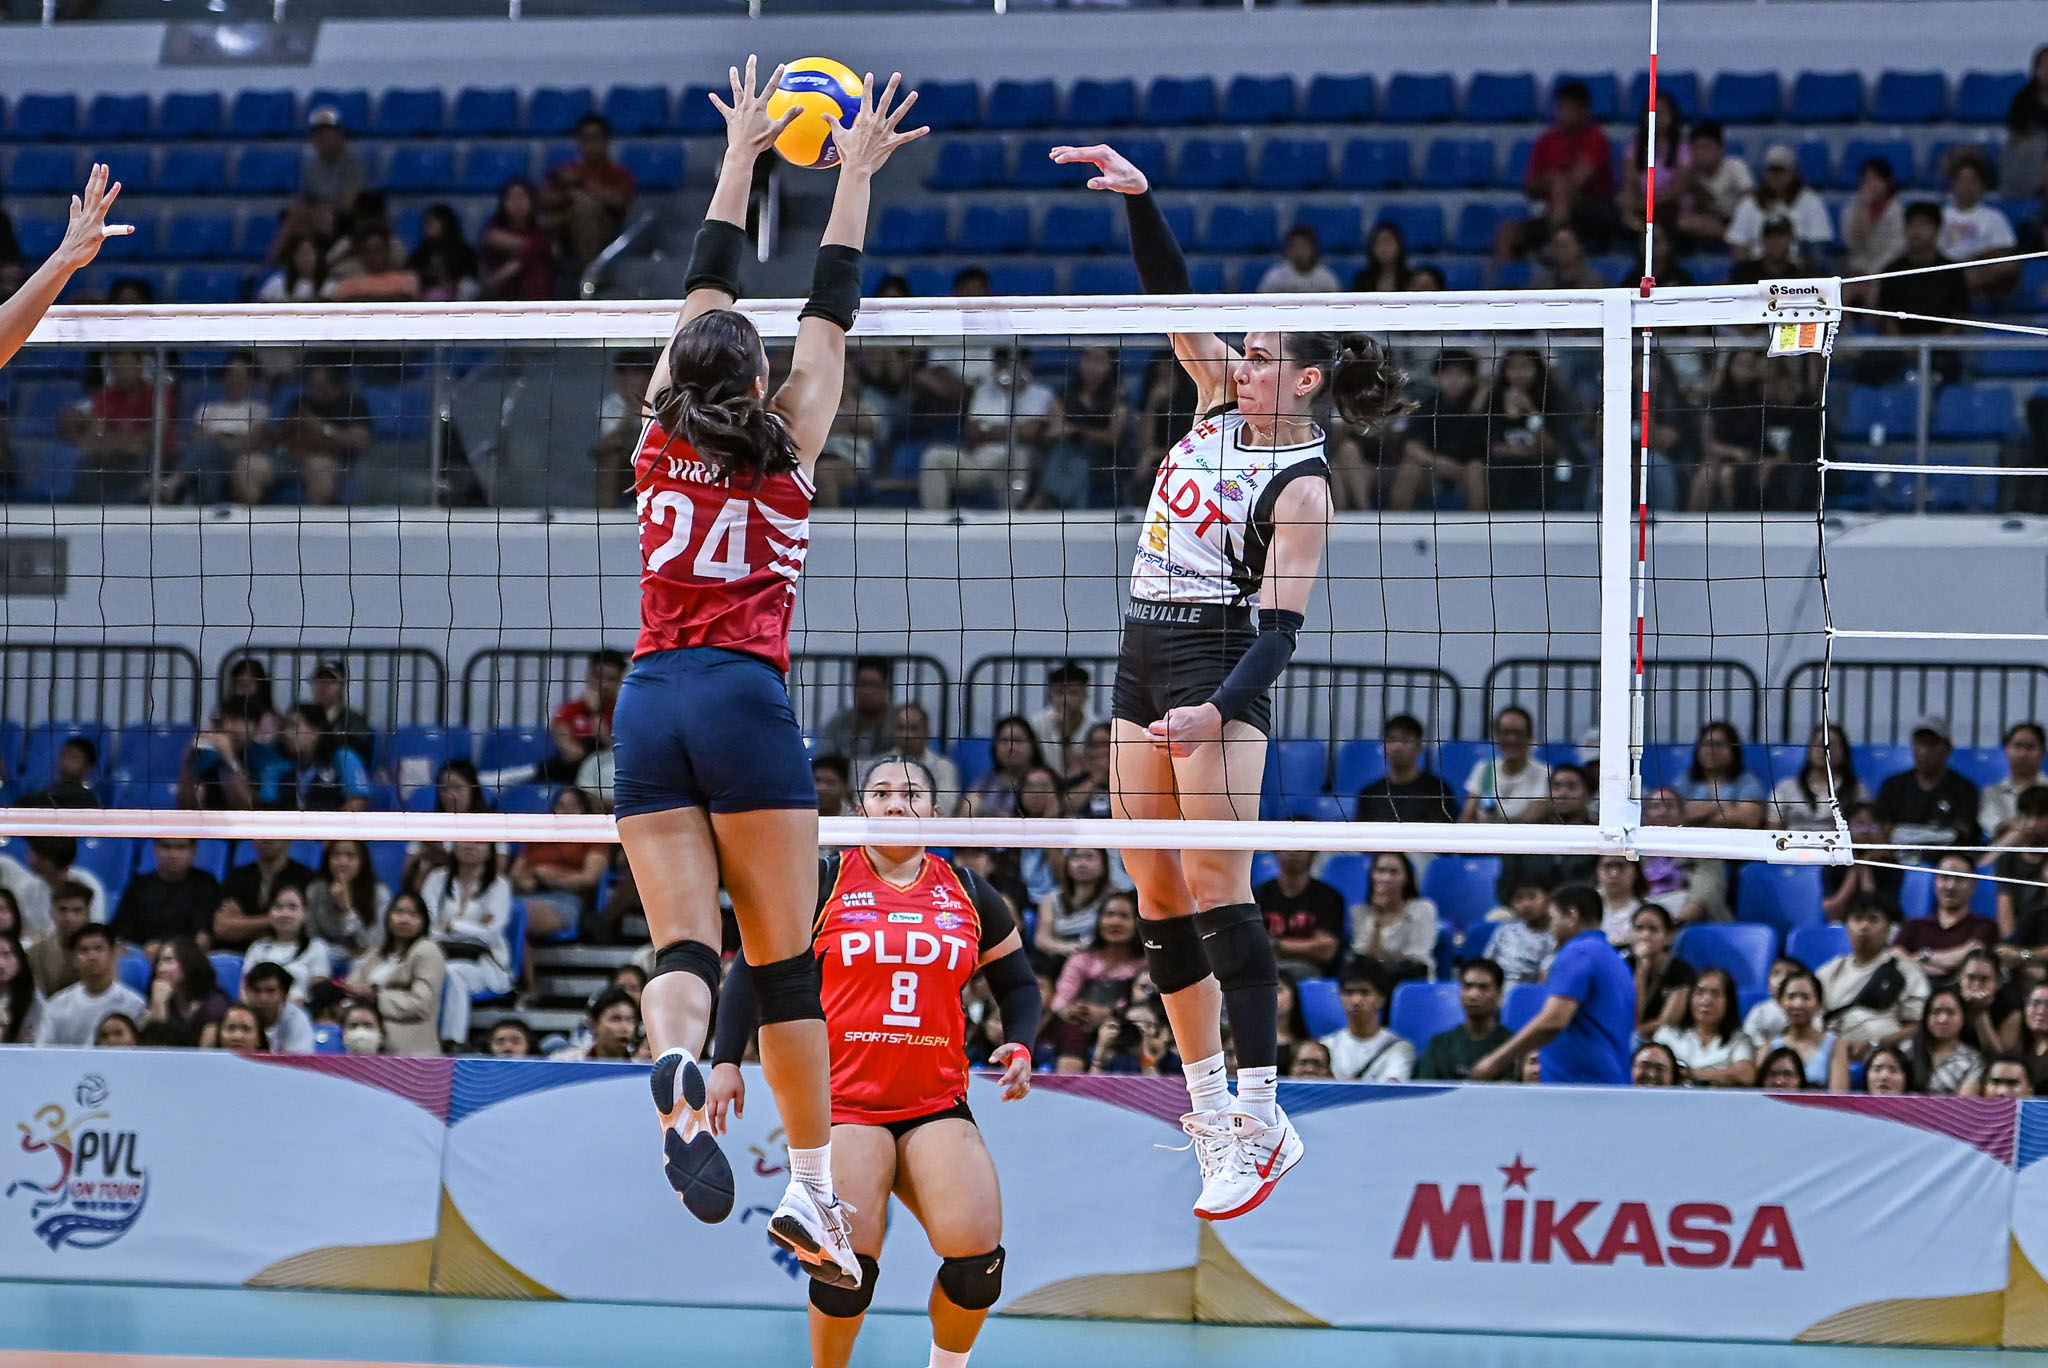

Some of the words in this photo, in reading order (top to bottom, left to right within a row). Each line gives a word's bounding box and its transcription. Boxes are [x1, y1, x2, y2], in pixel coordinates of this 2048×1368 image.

[1780, 286, 1819, 295] Senoh
[668, 456, 730, 489] VIRA
[1247, 478, 1258, 491] PVL
[647, 490, 751, 584] 24
[841, 891, 874, 900] GAME
[843, 899, 876, 908] VILLE
[840, 930, 967, 971] PLDT
[890, 970, 919, 1014] 8
[75, 1131, 142, 1177] PVL
[1392, 1154, 1806, 1271] MIKASA
